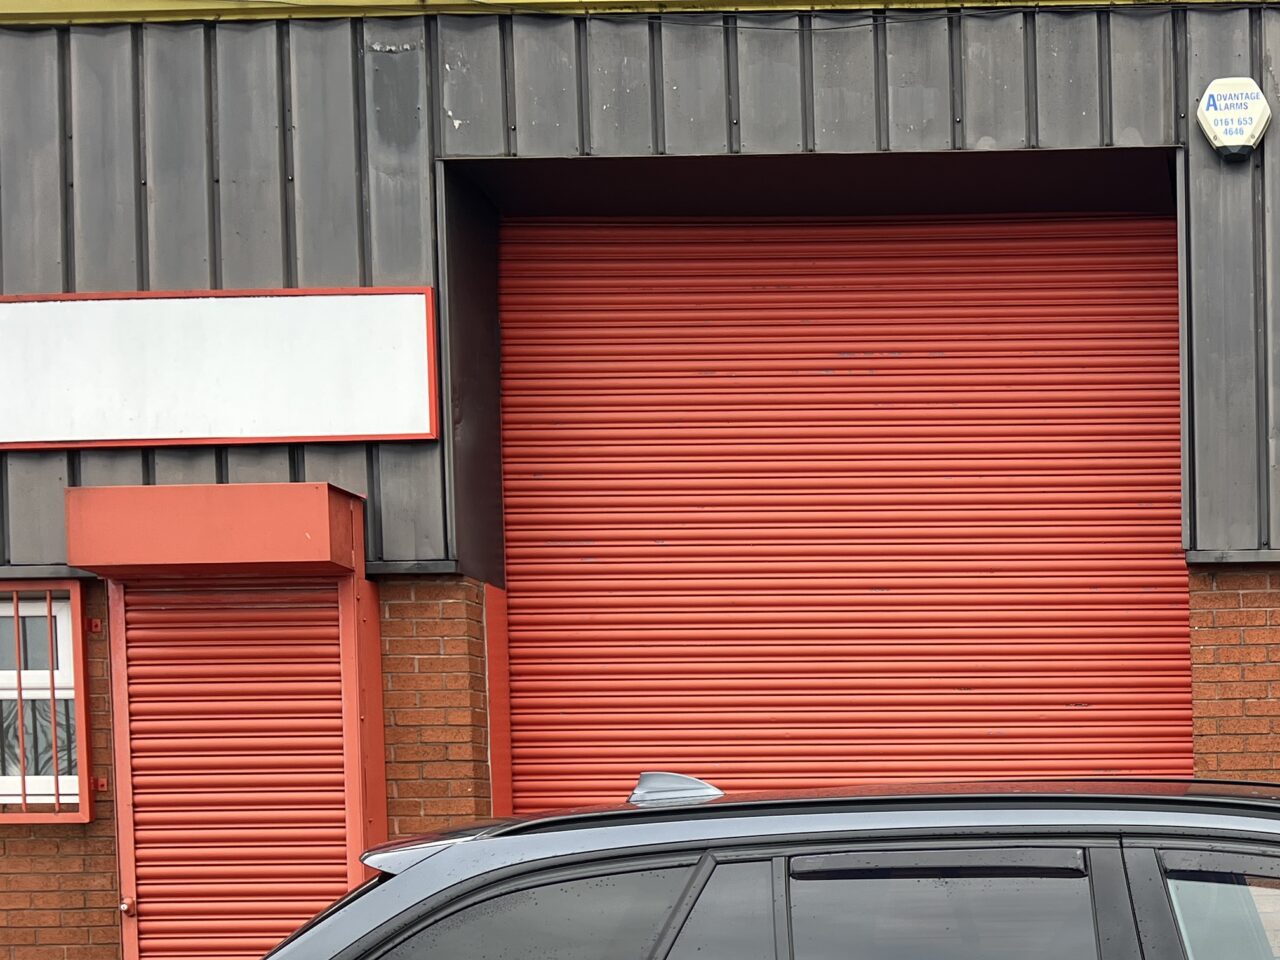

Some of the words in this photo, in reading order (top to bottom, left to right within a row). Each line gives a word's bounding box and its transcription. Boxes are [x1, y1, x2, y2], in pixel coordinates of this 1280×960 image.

[1206, 92, 1260, 111] ADVANTAGE
[1213, 118, 1234, 127] 0161
[1237, 117, 1253, 126] 653
